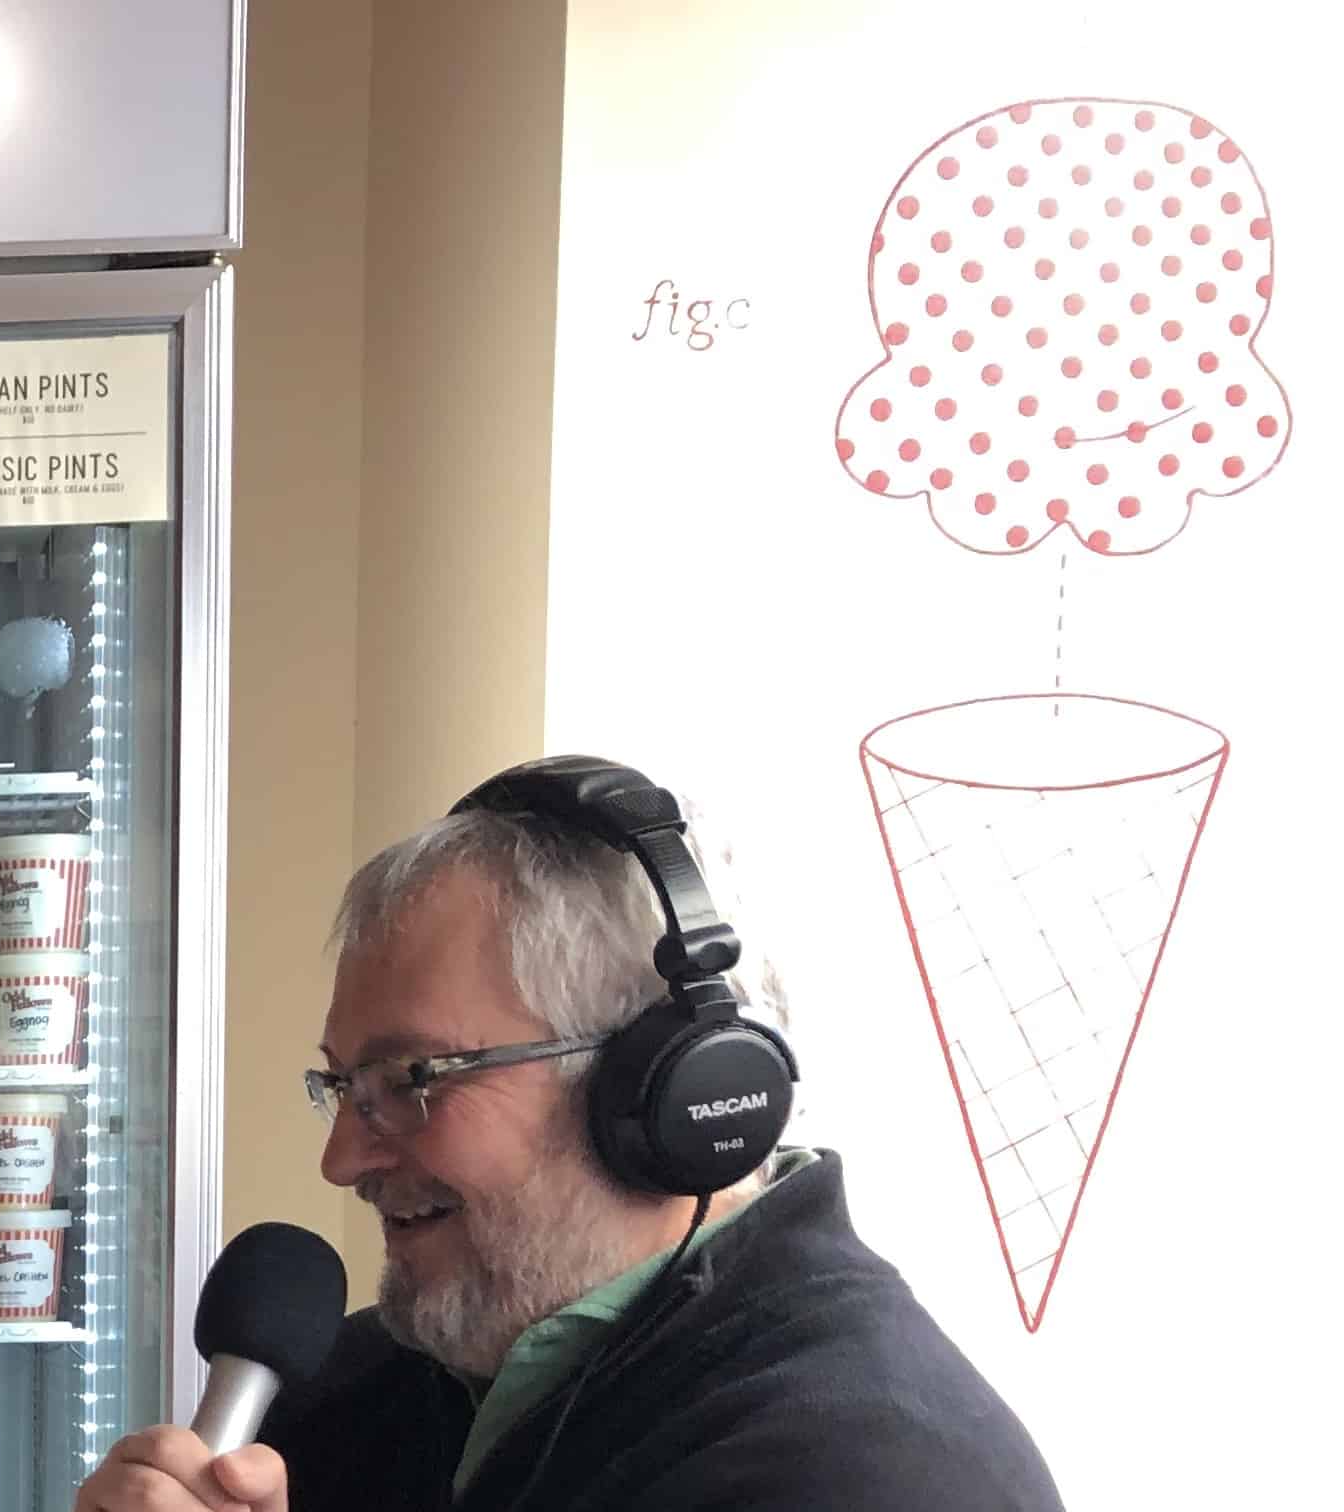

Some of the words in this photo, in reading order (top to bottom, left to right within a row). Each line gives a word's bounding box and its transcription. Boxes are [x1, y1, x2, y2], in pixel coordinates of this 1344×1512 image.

[39, 372, 109, 400] PINTS
[49, 453, 119, 480] PINTS
[9, 1016, 50, 1033] Eggnog
[688, 1092, 768, 1121] TASCAM
